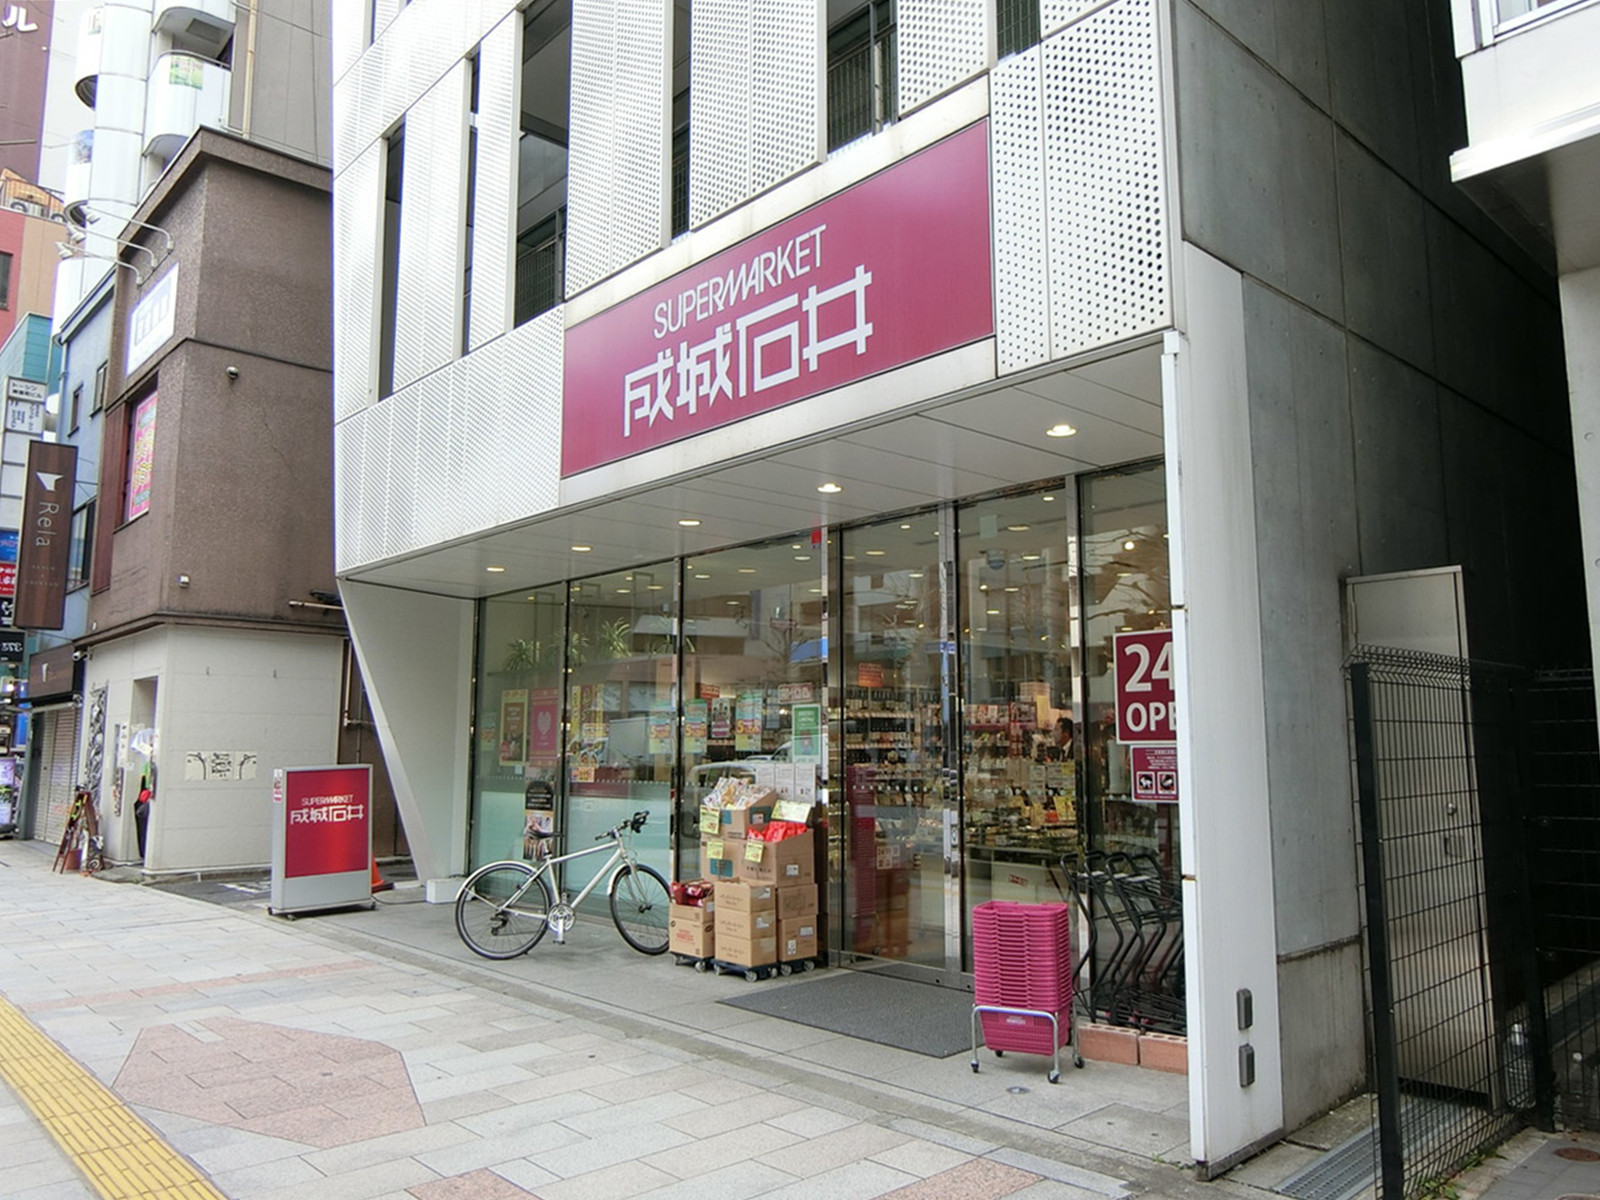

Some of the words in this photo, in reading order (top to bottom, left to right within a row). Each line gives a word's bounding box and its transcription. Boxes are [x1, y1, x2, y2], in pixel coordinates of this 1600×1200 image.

[652, 223, 827, 340] SUPERMARKET
[623, 264, 874, 438] 成城石井
[35, 501, 60, 547] Rela
[290, 804, 364, 825] 成城石井
[301, 794, 354, 806] SUPERMARKET
